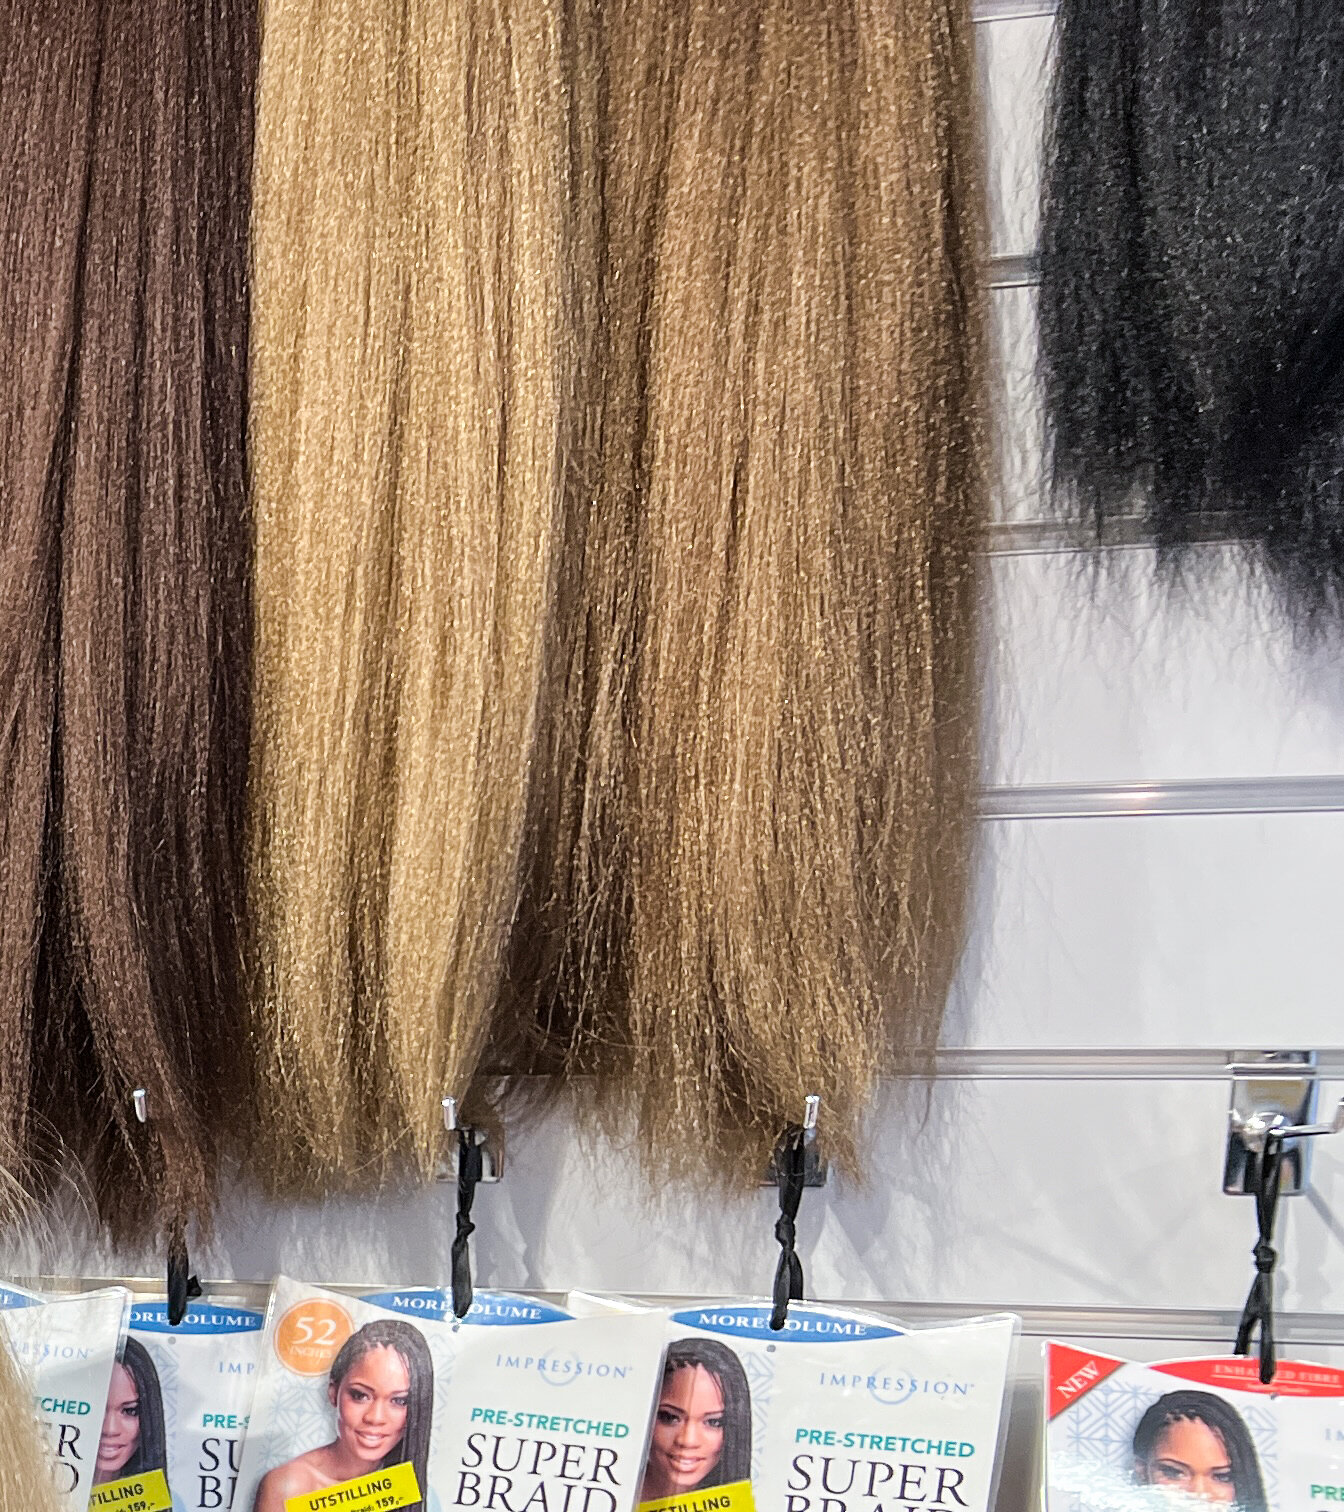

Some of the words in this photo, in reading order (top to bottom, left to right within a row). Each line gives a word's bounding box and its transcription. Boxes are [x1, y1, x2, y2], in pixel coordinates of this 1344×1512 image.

[129, 1311, 167, 1324] ORE
[184, 1313, 257, 1327] OLUME
[392, 1296, 452, 1311] MORE
[470, 1303, 542, 1319] OLUME
[292, 1316, 337, 1345] 52
[698, 1313, 764, 1328] MORE
[784, 1319, 867, 1336] OLUME
[495, 1354, 627, 1379] IMPRESSION
[1056, 1360, 1101, 1399] NEW
[819, 1372, 970, 1396] IMPRESSION
[470, 1407, 630, 1438] PRE-STRETCHED
[795, 1428, 976, 1458] PRE-STRETCHED
[461, 1432, 622, 1486] SUPER
[91, 1483, 144, 1507] TILLING
[309, 1478, 393, 1512] UTSTILLING
[787, 1454, 970, 1507] SUPER
